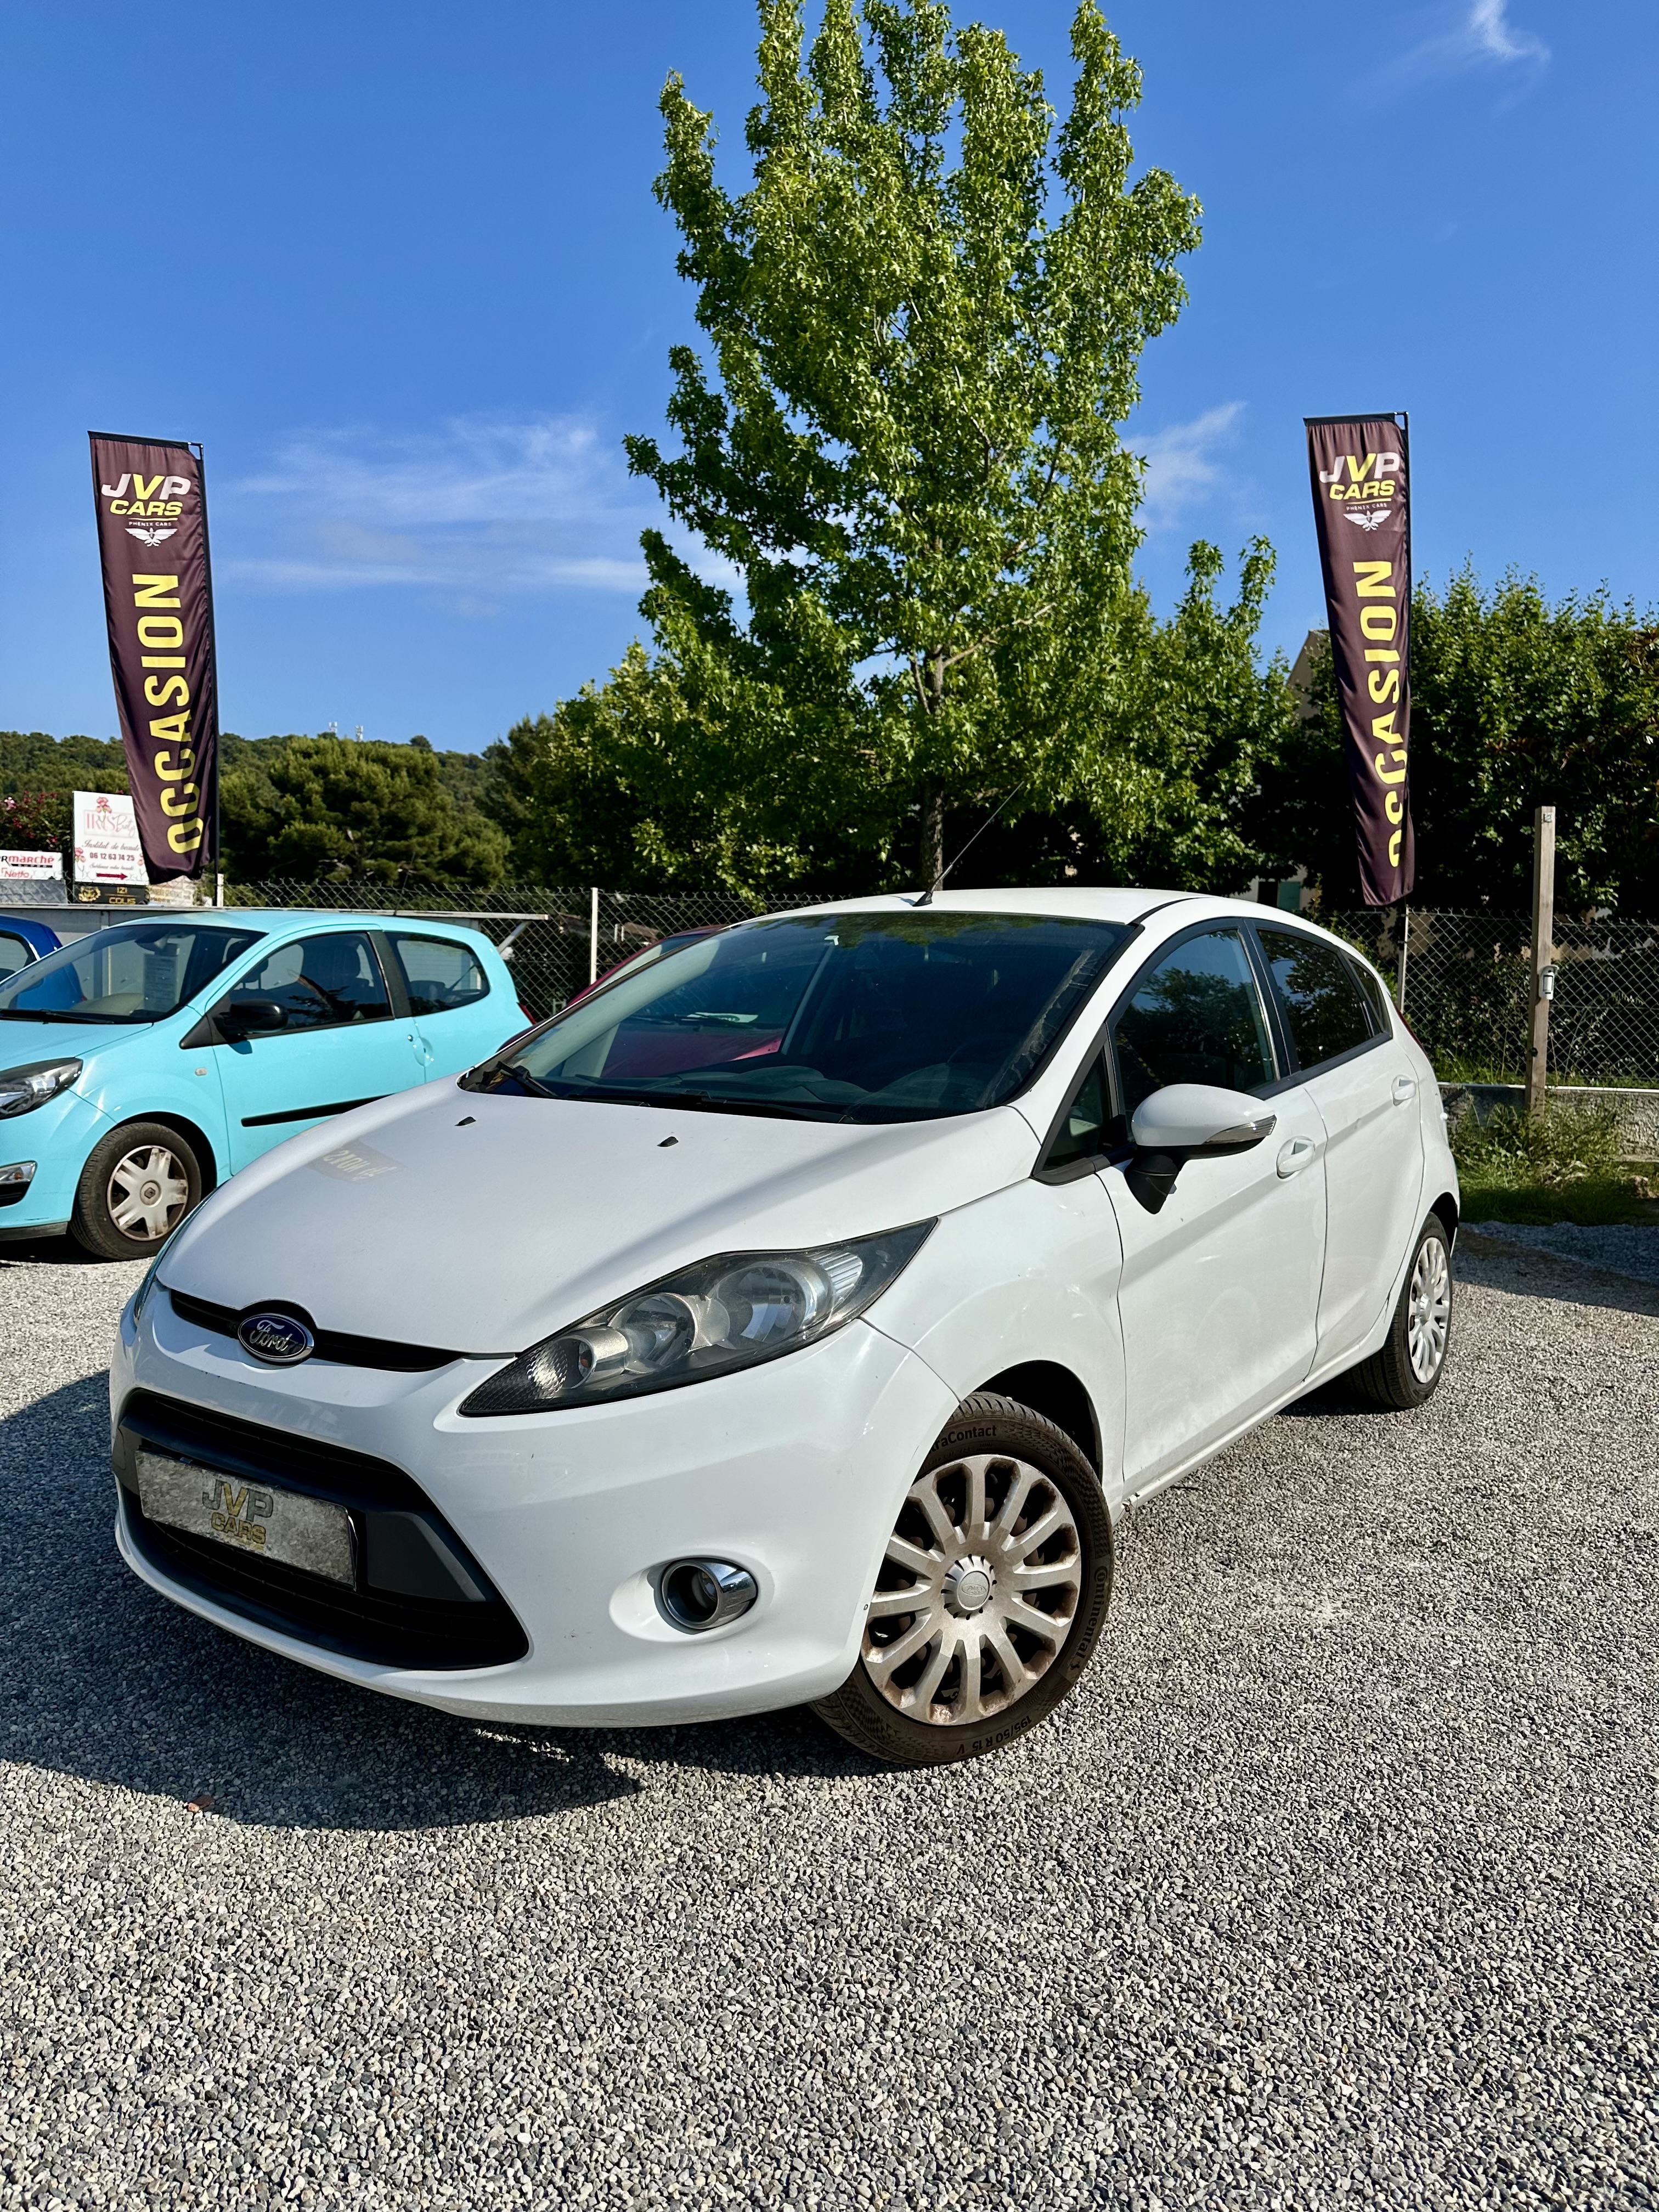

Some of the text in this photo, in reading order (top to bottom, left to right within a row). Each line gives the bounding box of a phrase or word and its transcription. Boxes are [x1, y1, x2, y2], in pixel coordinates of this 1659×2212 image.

[1319, 452, 1400, 483] JVP
[101, 473, 191, 500] JVP
[1329, 479, 1396, 500] CARS
[110, 499, 183, 516] CARS
[132, 574, 204, 854] OCCASION
[0, 855, 55, 865] Rmarché
[249, 1319, 293, 1352] Ford
[201, 1479, 274, 1522] JVP
[211, 1511, 267, 1545] CARS
[1075, 1565, 1108, 1659] Continental
[956, 1716, 1032, 1755] 195/50 R 15 V
